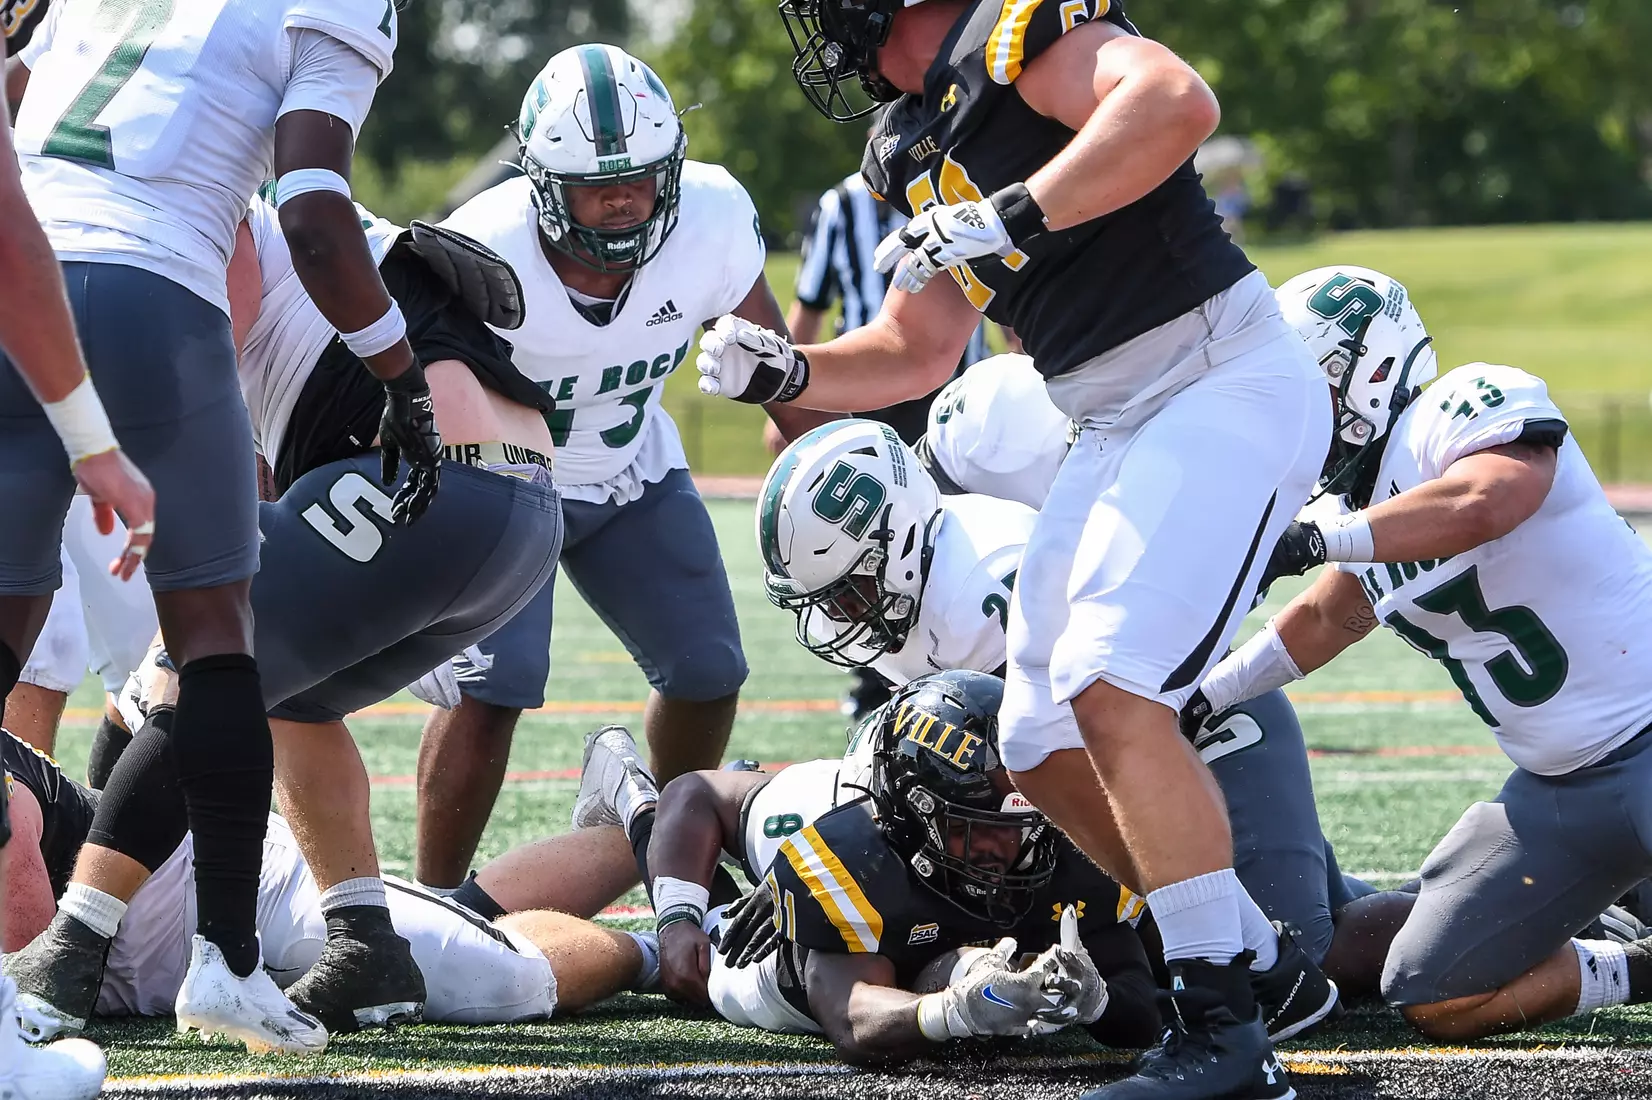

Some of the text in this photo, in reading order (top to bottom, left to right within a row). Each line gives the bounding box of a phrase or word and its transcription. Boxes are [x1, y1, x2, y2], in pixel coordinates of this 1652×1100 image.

[908, 135, 940, 163] VILLE
[598, 157, 632, 173] ROCK
[607, 239, 635, 251] Riddell
[645, 311, 683, 327] adidas
[1306, 272, 1385, 338] S
[811, 459, 887, 542] S
[301, 473, 396, 562] S
[892, 701, 984, 771] VILLE
[763, 813, 803, 838] 8
[911, 927, 938, 941] PSAC
[1277, 970, 1306, 1017] ARMOUR
